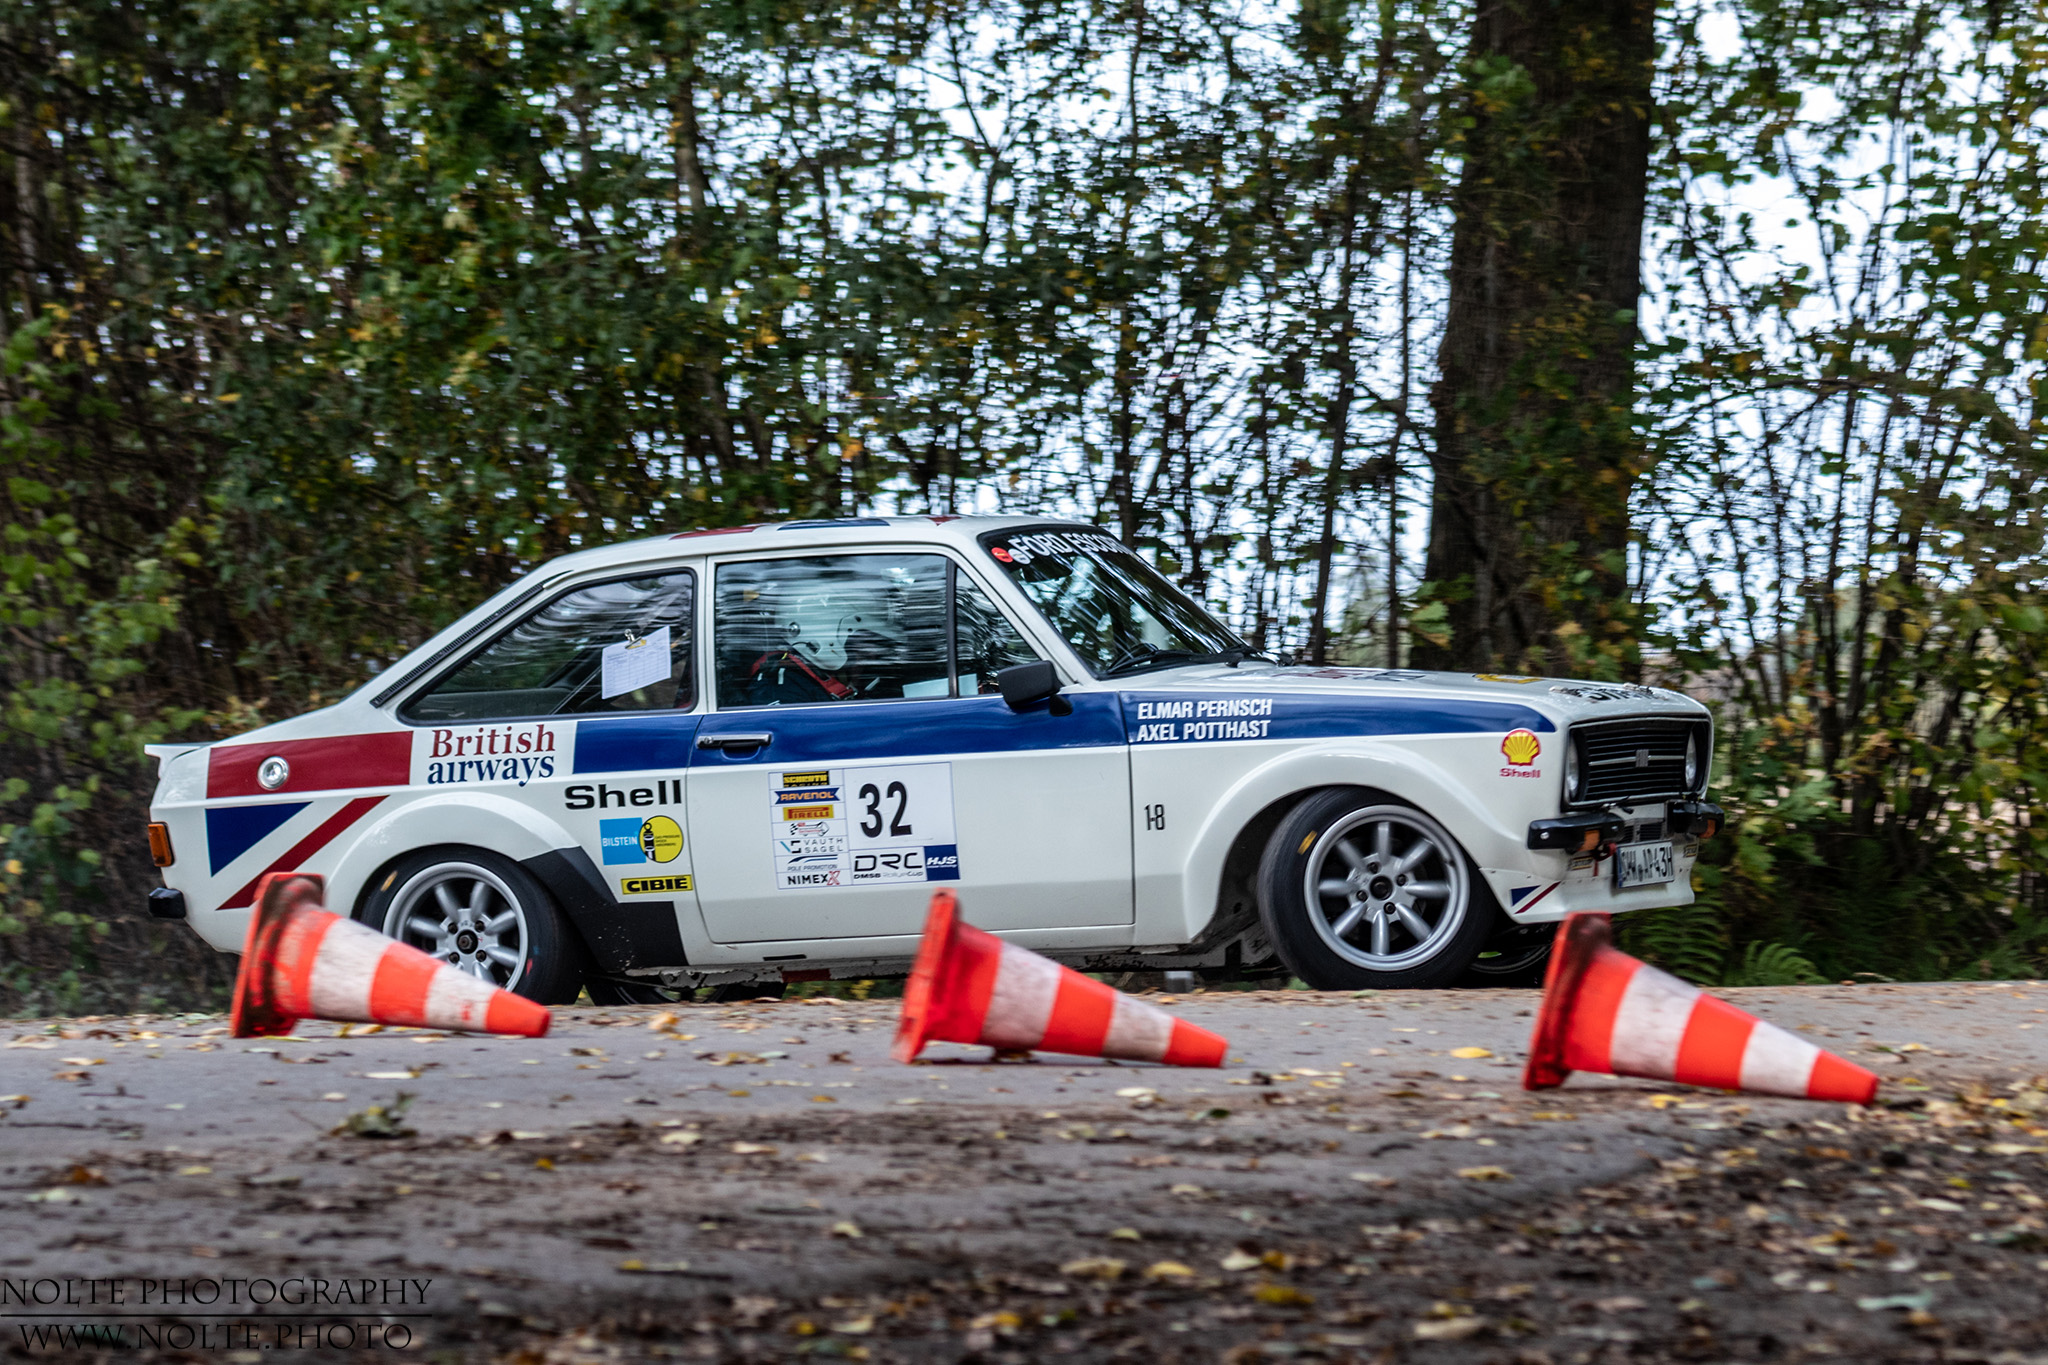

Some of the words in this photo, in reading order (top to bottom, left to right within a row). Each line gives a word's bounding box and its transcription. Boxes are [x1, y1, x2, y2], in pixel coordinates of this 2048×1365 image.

[1007, 533, 1073, 559] FORD
[1137, 701, 1193, 720] ELMAR
[1196, 698, 1273, 718] PERNSCH
[429, 724, 555, 758] British
[1136, 723, 1179, 742] AXEL
[1182, 720, 1271, 740] POTTHAST
[427, 755, 554, 787] airways
[1499, 768, 1541, 778] Shell
[565, 779, 682, 810] Shell
[780, 791, 835, 801] RAVENOL
[787, 806, 830, 819] PIRELLI
[858, 780, 913, 838] 32
[602, 836, 638, 847] BILSTEIN
[803, 838, 843, 846] VAUTH
[804, 845, 843, 853] SAGEL
[854, 852, 923, 872] DRC
[926, 856, 957, 866] HJS
